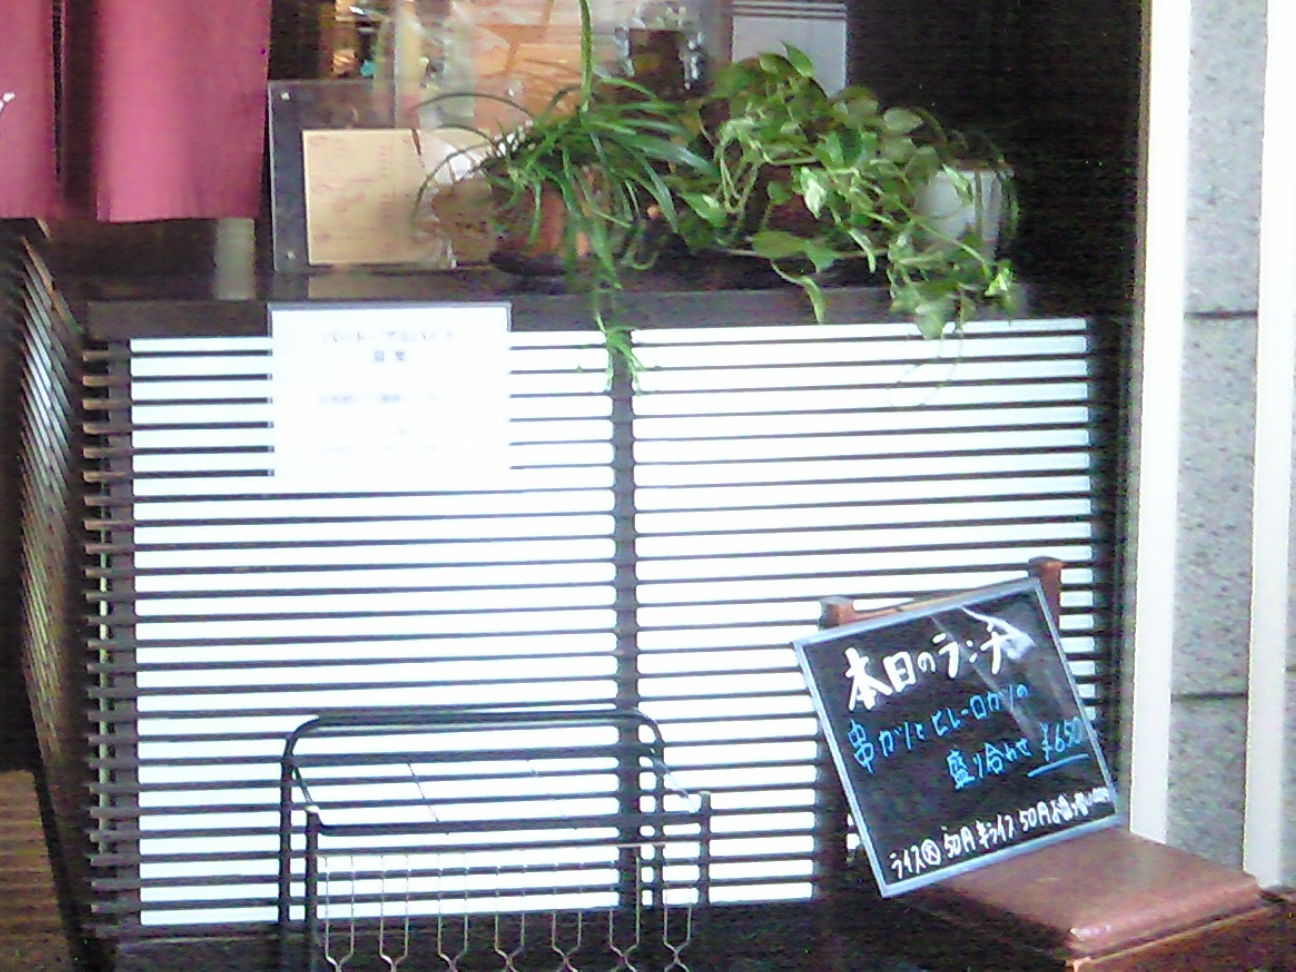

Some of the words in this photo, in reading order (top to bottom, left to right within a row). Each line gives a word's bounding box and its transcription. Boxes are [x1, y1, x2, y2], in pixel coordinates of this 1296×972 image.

[844, 622, 1017, 712] 本日のランチ
